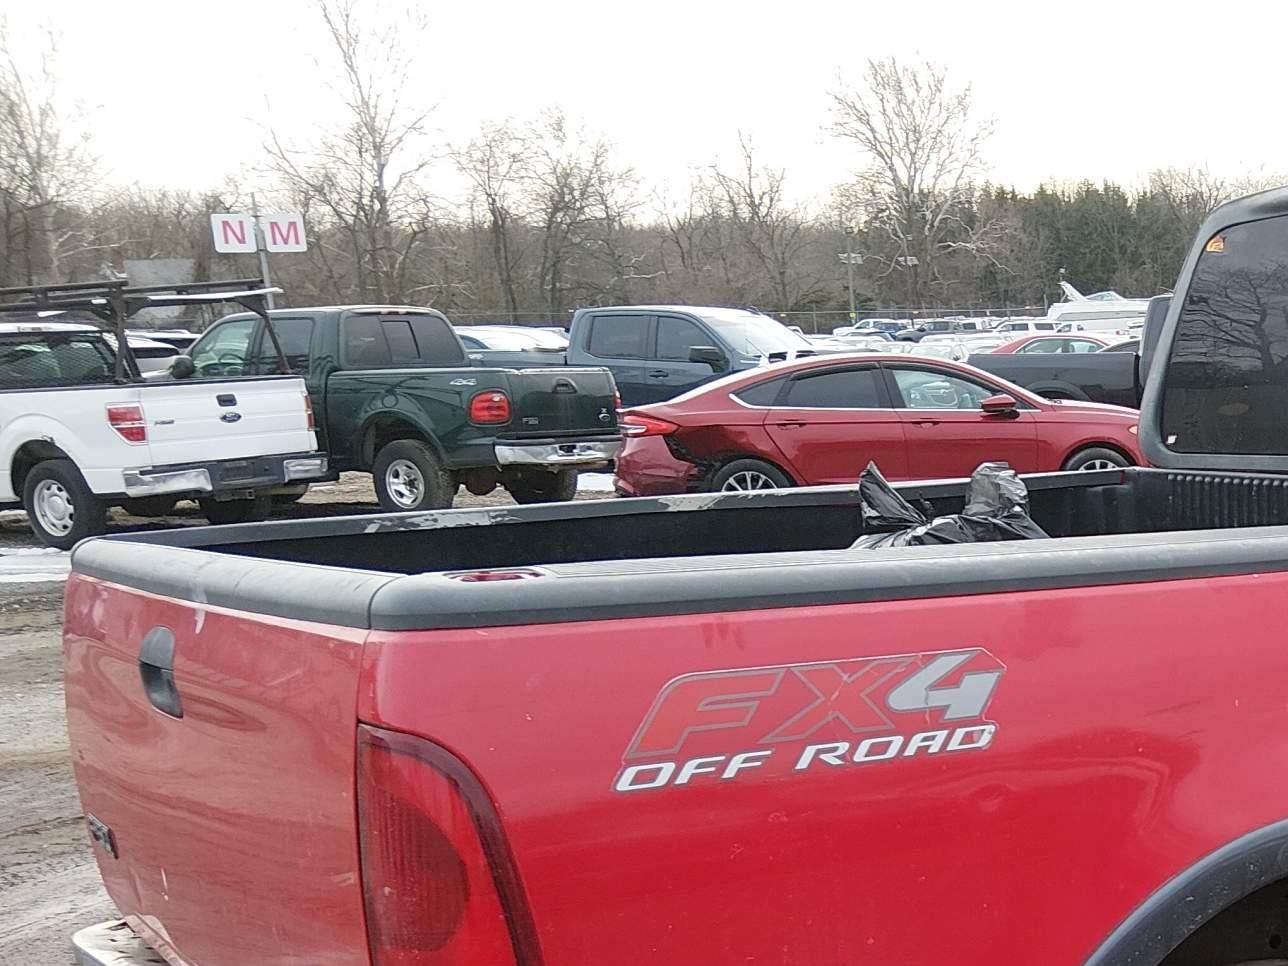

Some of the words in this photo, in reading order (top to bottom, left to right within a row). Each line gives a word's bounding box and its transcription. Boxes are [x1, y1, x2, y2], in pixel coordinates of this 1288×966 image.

[221, 220, 247, 245] N
[269, 221, 300, 246] M
[626, 651, 1001, 758] FX4
[615, 750, 772, 792] OFF
[795, 724, 997, 771] ROAD
